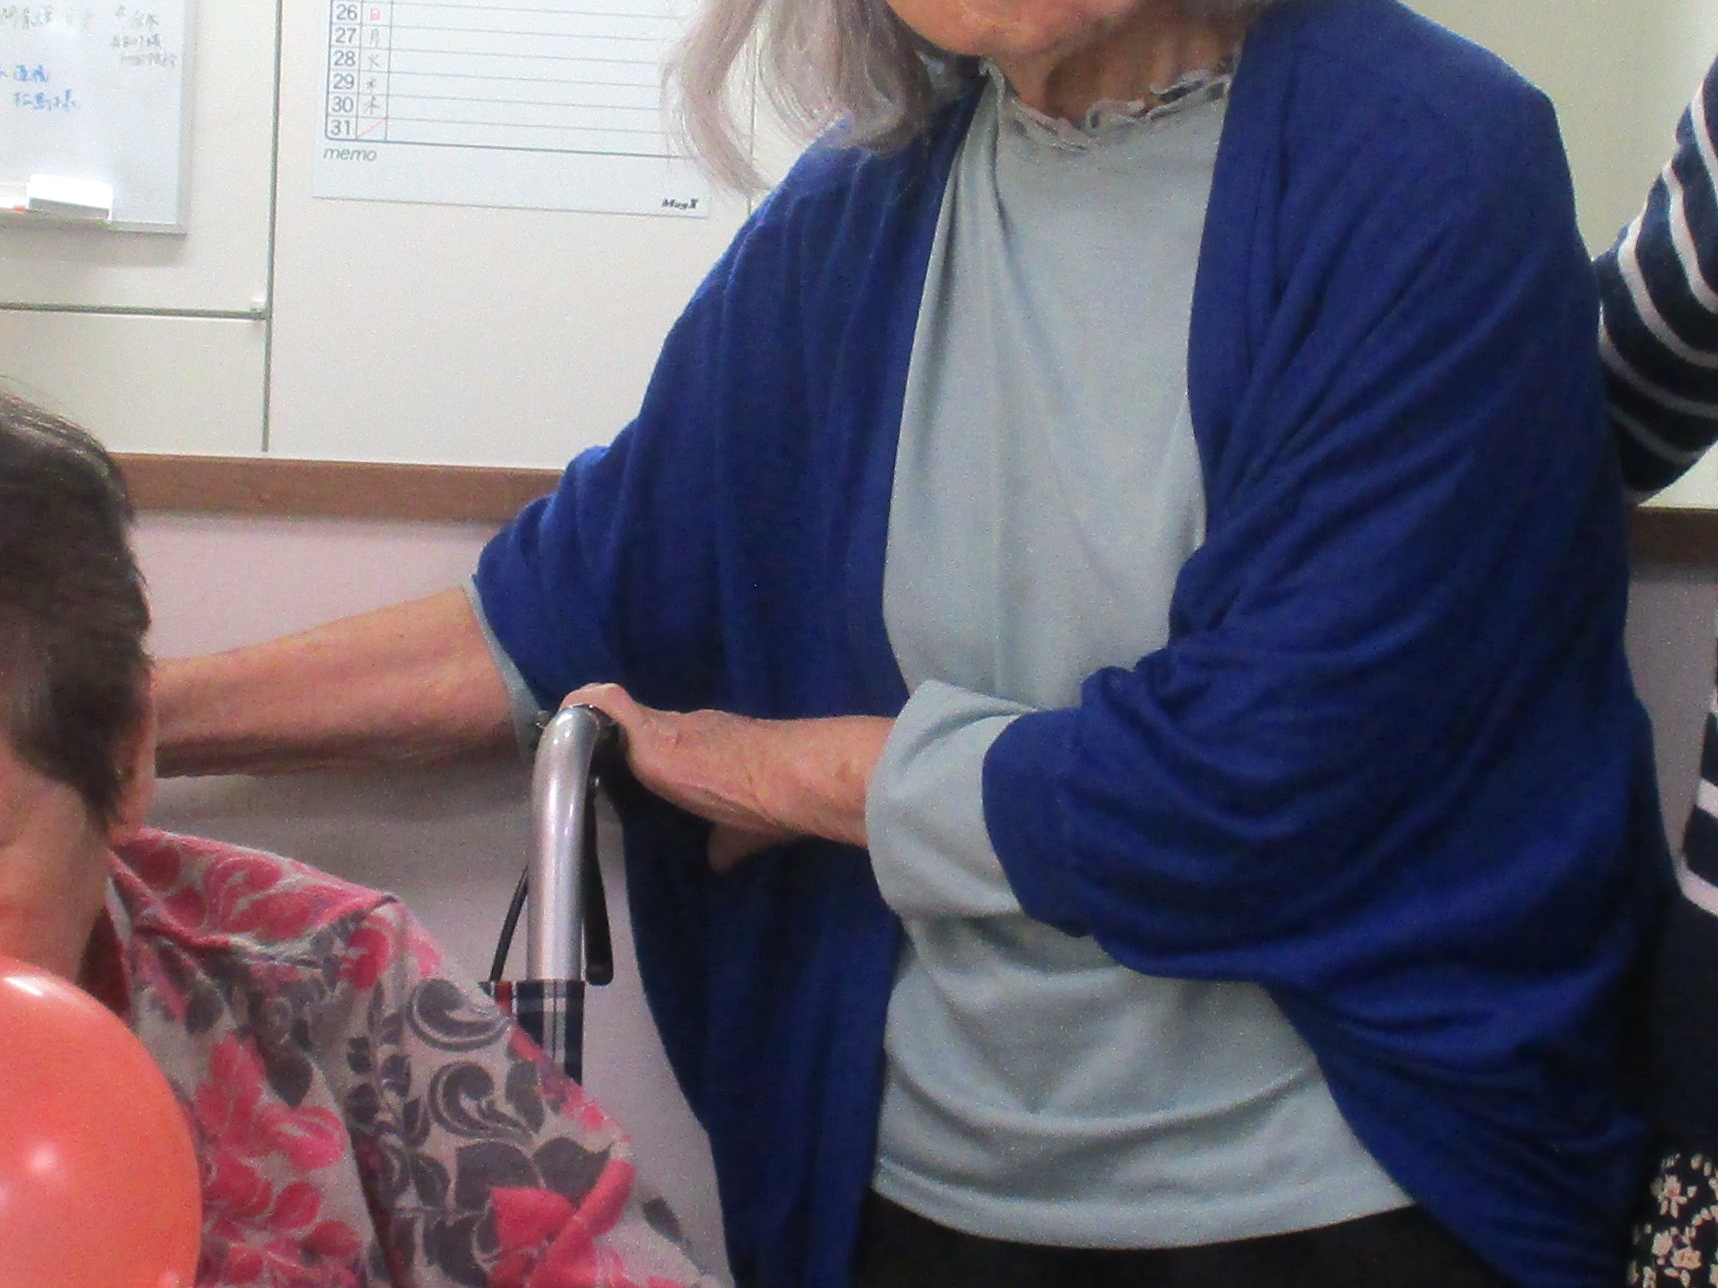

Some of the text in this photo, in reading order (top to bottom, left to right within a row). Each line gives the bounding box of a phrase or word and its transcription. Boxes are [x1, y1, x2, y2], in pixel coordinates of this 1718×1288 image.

[336, 4, 358, 21] 26
[335, 27, 357, 44] 27
[334, 50, 356, 67] 28
[333, 72, 355, 89] 29
[332, 96, 355, 114] 30
[331, 119, 350, 137] 31
[322, 146, 378, 162] memo
